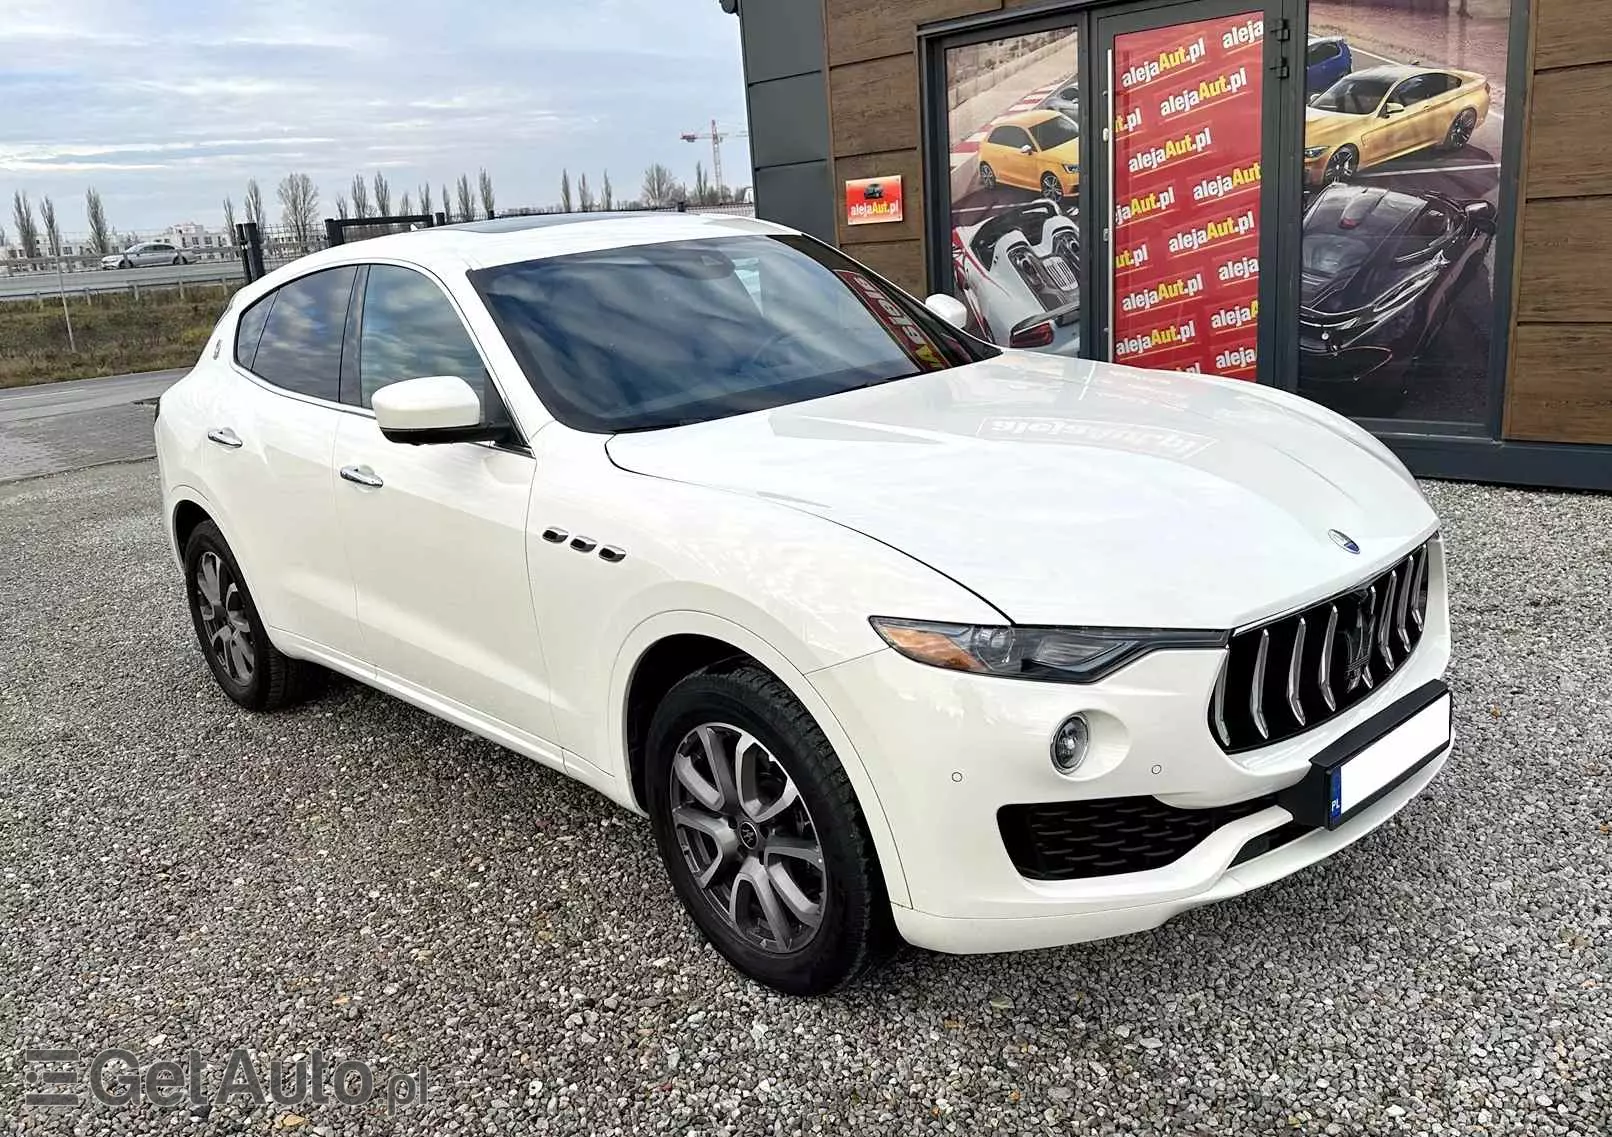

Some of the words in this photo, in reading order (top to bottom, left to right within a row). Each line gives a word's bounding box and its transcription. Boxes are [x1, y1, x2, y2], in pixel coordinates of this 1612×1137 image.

[1222, 20, 1263, 48] aleja
[1121, 37, 1206, 87] alejaAut.pl
[1160, 67, 1247, 116] alejaAut.pl
[1128, 127, 1212, 173] alejaAut.pl
[1193, 162, 1261, 200] alejaAut
[850, 200, 899, 217] alejaAut.pl
[1115, 186, 1175, 225] jaAut.pl
[1168, 211, 1255, 252] alejaAut.pl
[1218, 257, 1259, 280] aleja
[1122, 273, 1203, 311] alejaAut.pl
[1116, 320, 1195, 355] alejaAut.pl
[1216, 347, 1256, 369] aleja
[1331, 798, 1340, 811] PL
